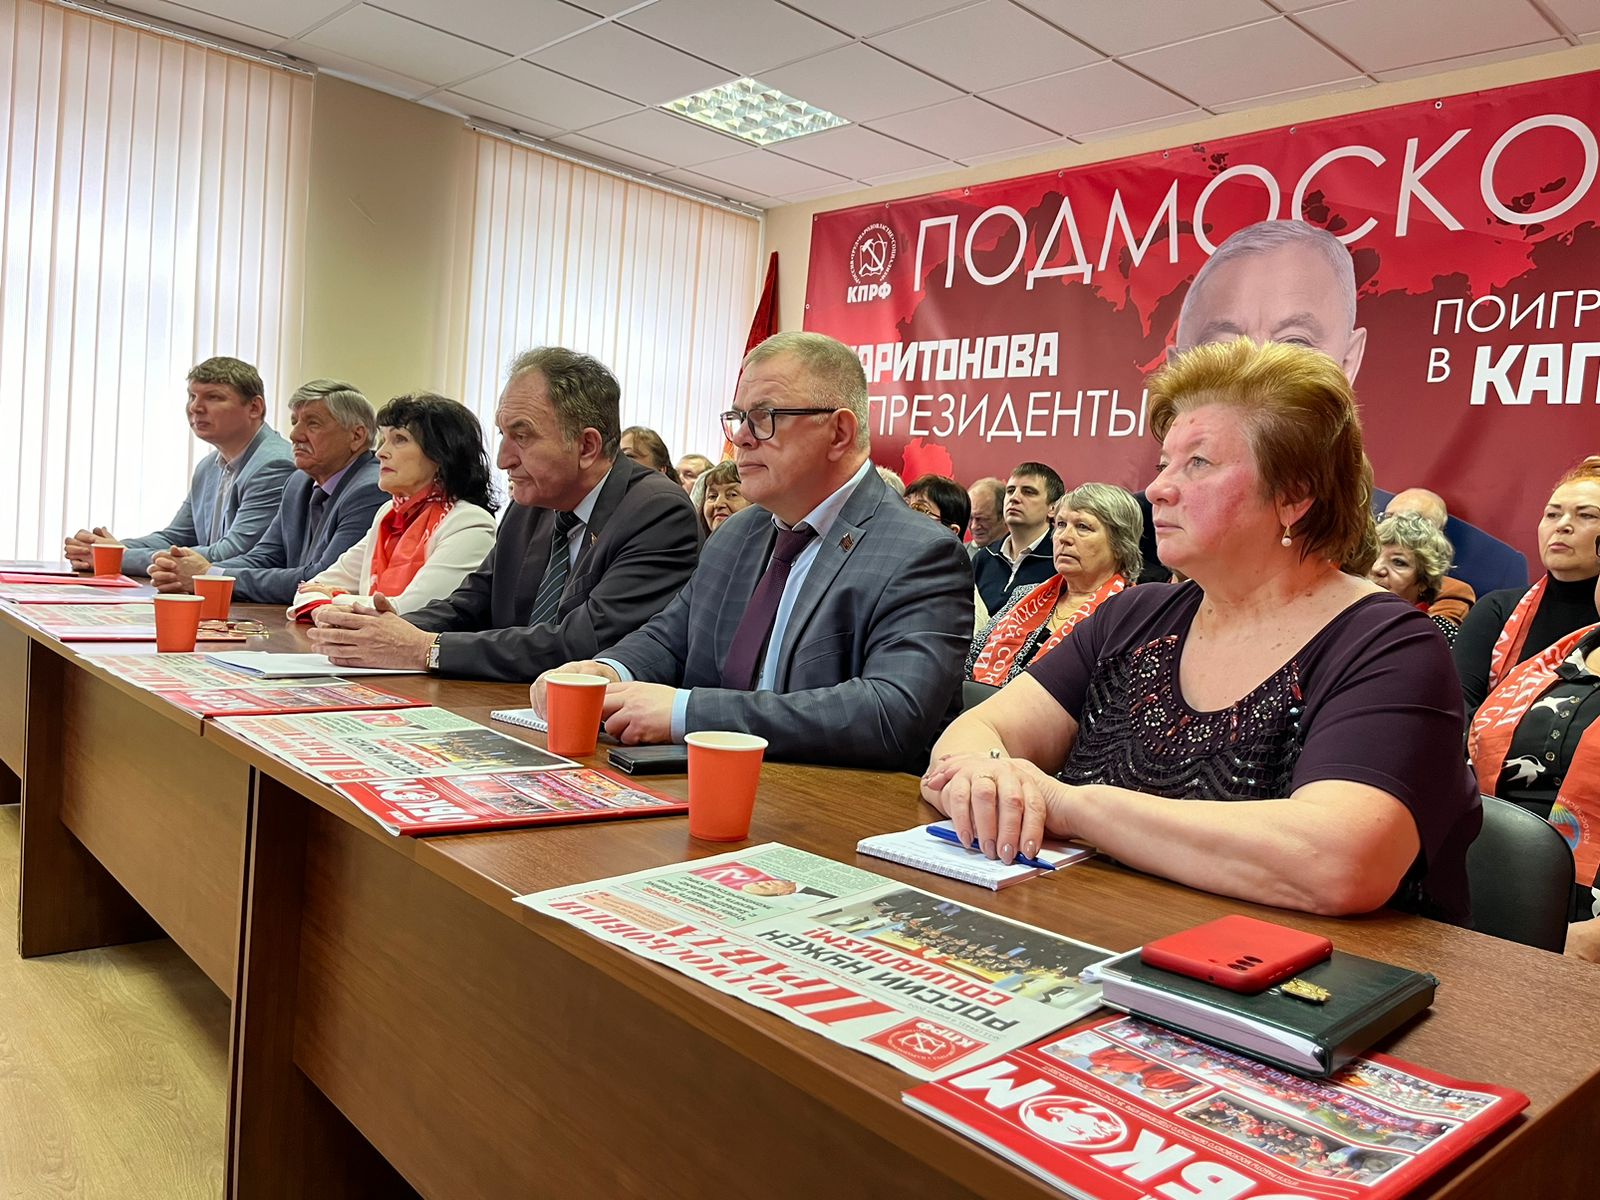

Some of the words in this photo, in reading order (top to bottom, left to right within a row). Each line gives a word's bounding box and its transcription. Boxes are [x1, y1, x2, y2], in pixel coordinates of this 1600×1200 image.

[913, 114, 1600, 291] ПОДМОСКО
[847, 281, 892, 304] КПРФ
[1432, 289, 1600, 335] ПОИГР
[851, 332, 1059, 383] АРИТОНОВА
[1427, 347, 1450, 383] В
[868, 388, 1149, 443] ПРЕЗИДЕНТЫ
[754, 929, 875, 974] НУЖЕН
[799, 926, 1016, 1007] СОЦИАЛИЗМ!
[864, 970, 1020, 1031] РОССИИ
[950, 1061, 1313, 1200] БКОМ
